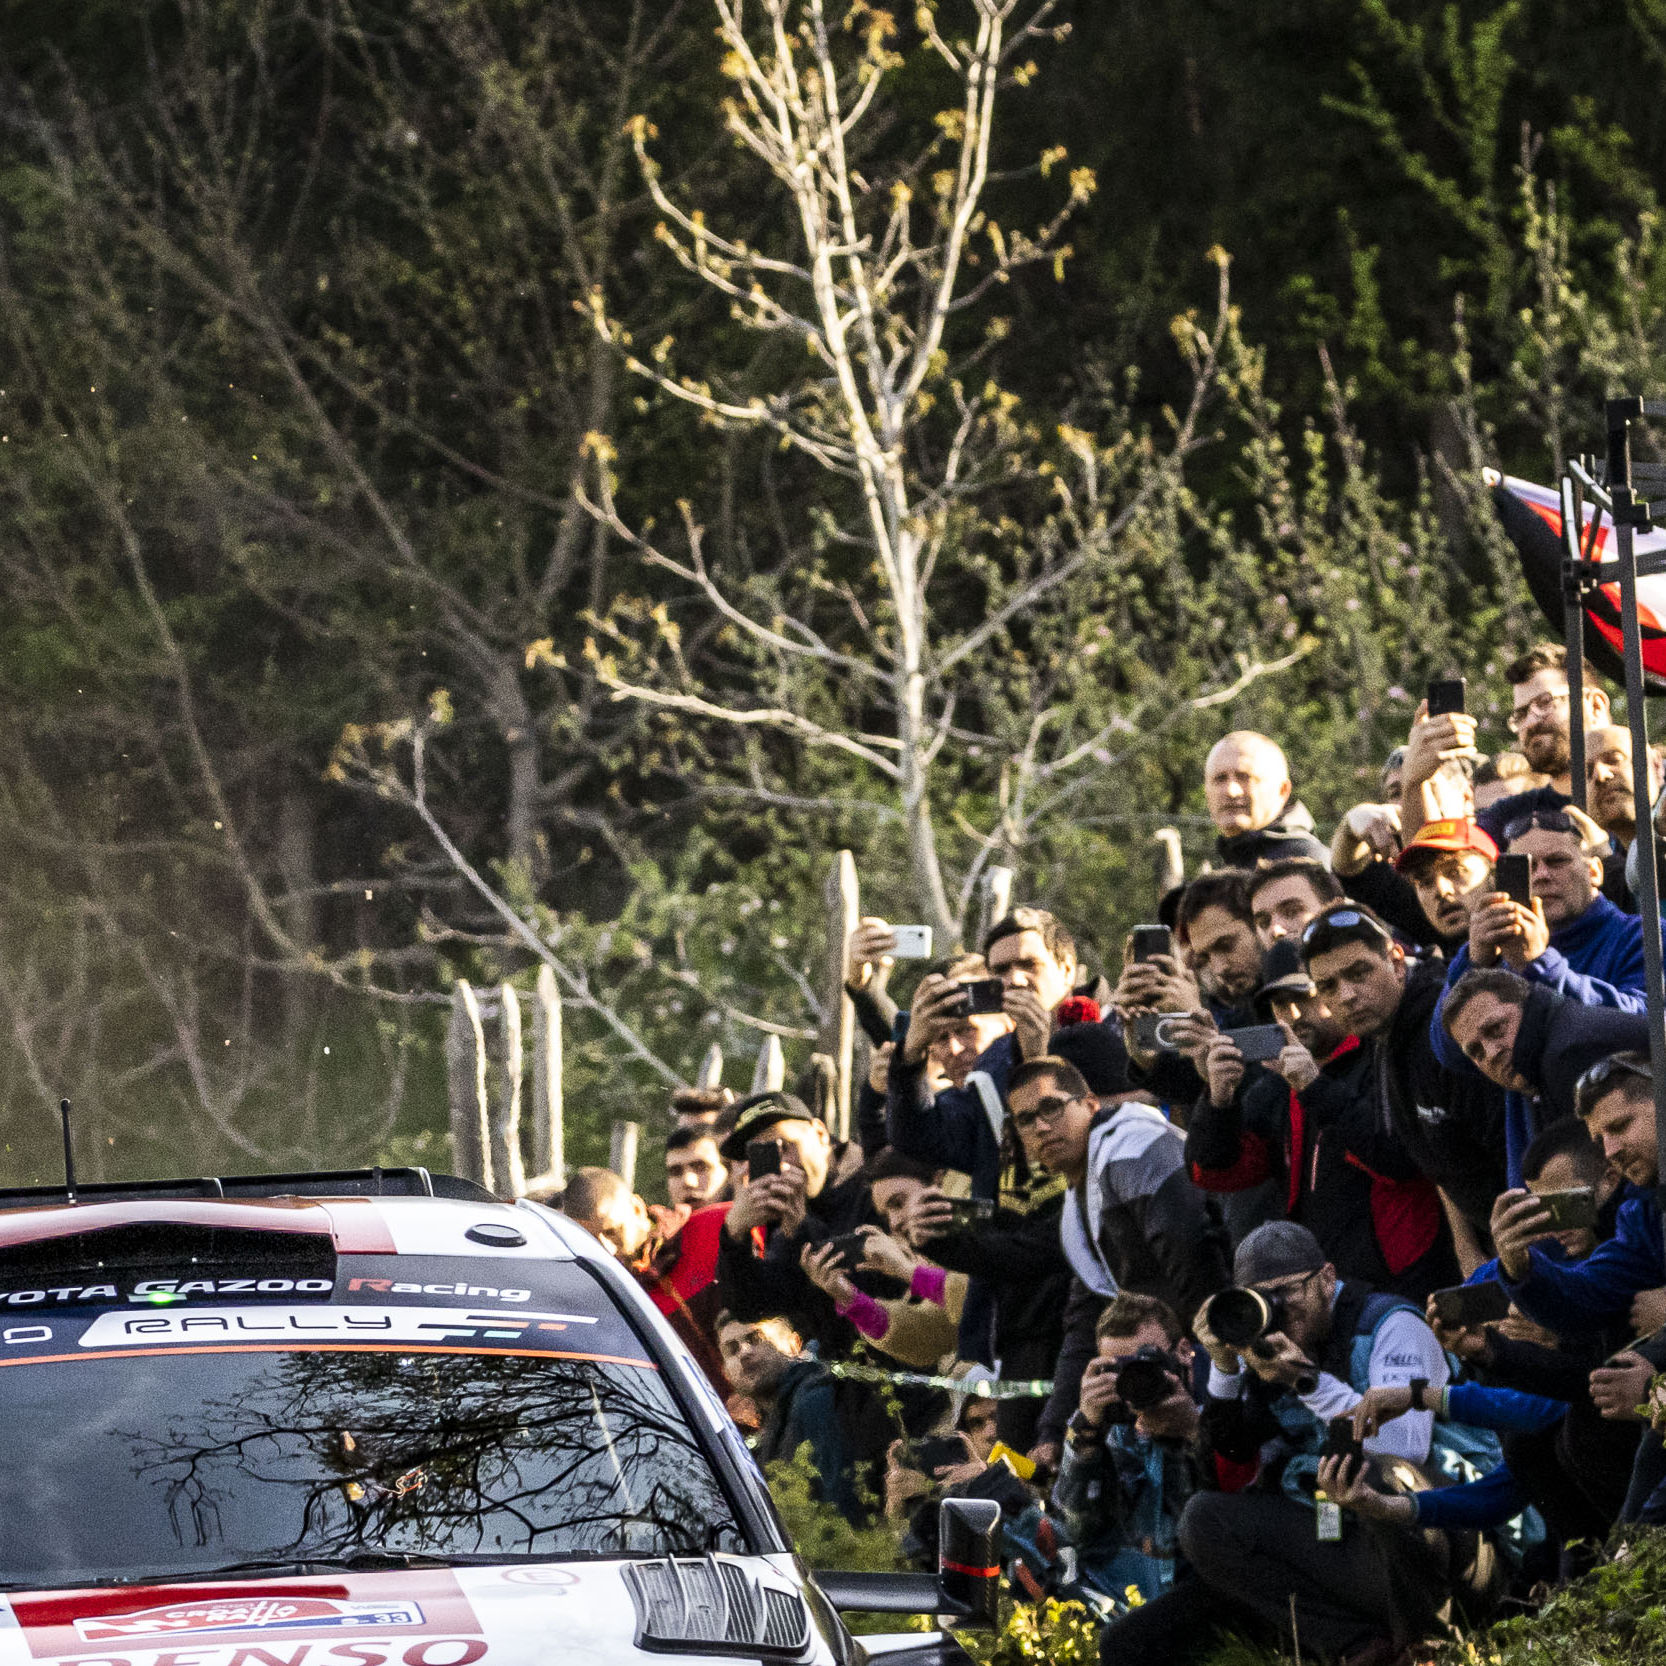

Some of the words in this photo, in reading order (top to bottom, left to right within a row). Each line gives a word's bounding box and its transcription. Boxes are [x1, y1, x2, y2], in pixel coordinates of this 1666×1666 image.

[133, 1278, 333, 1296] GAZOO
[347, 1277, 532, 1303] Racing
[124, 1314, 392, 1335] RALLY
